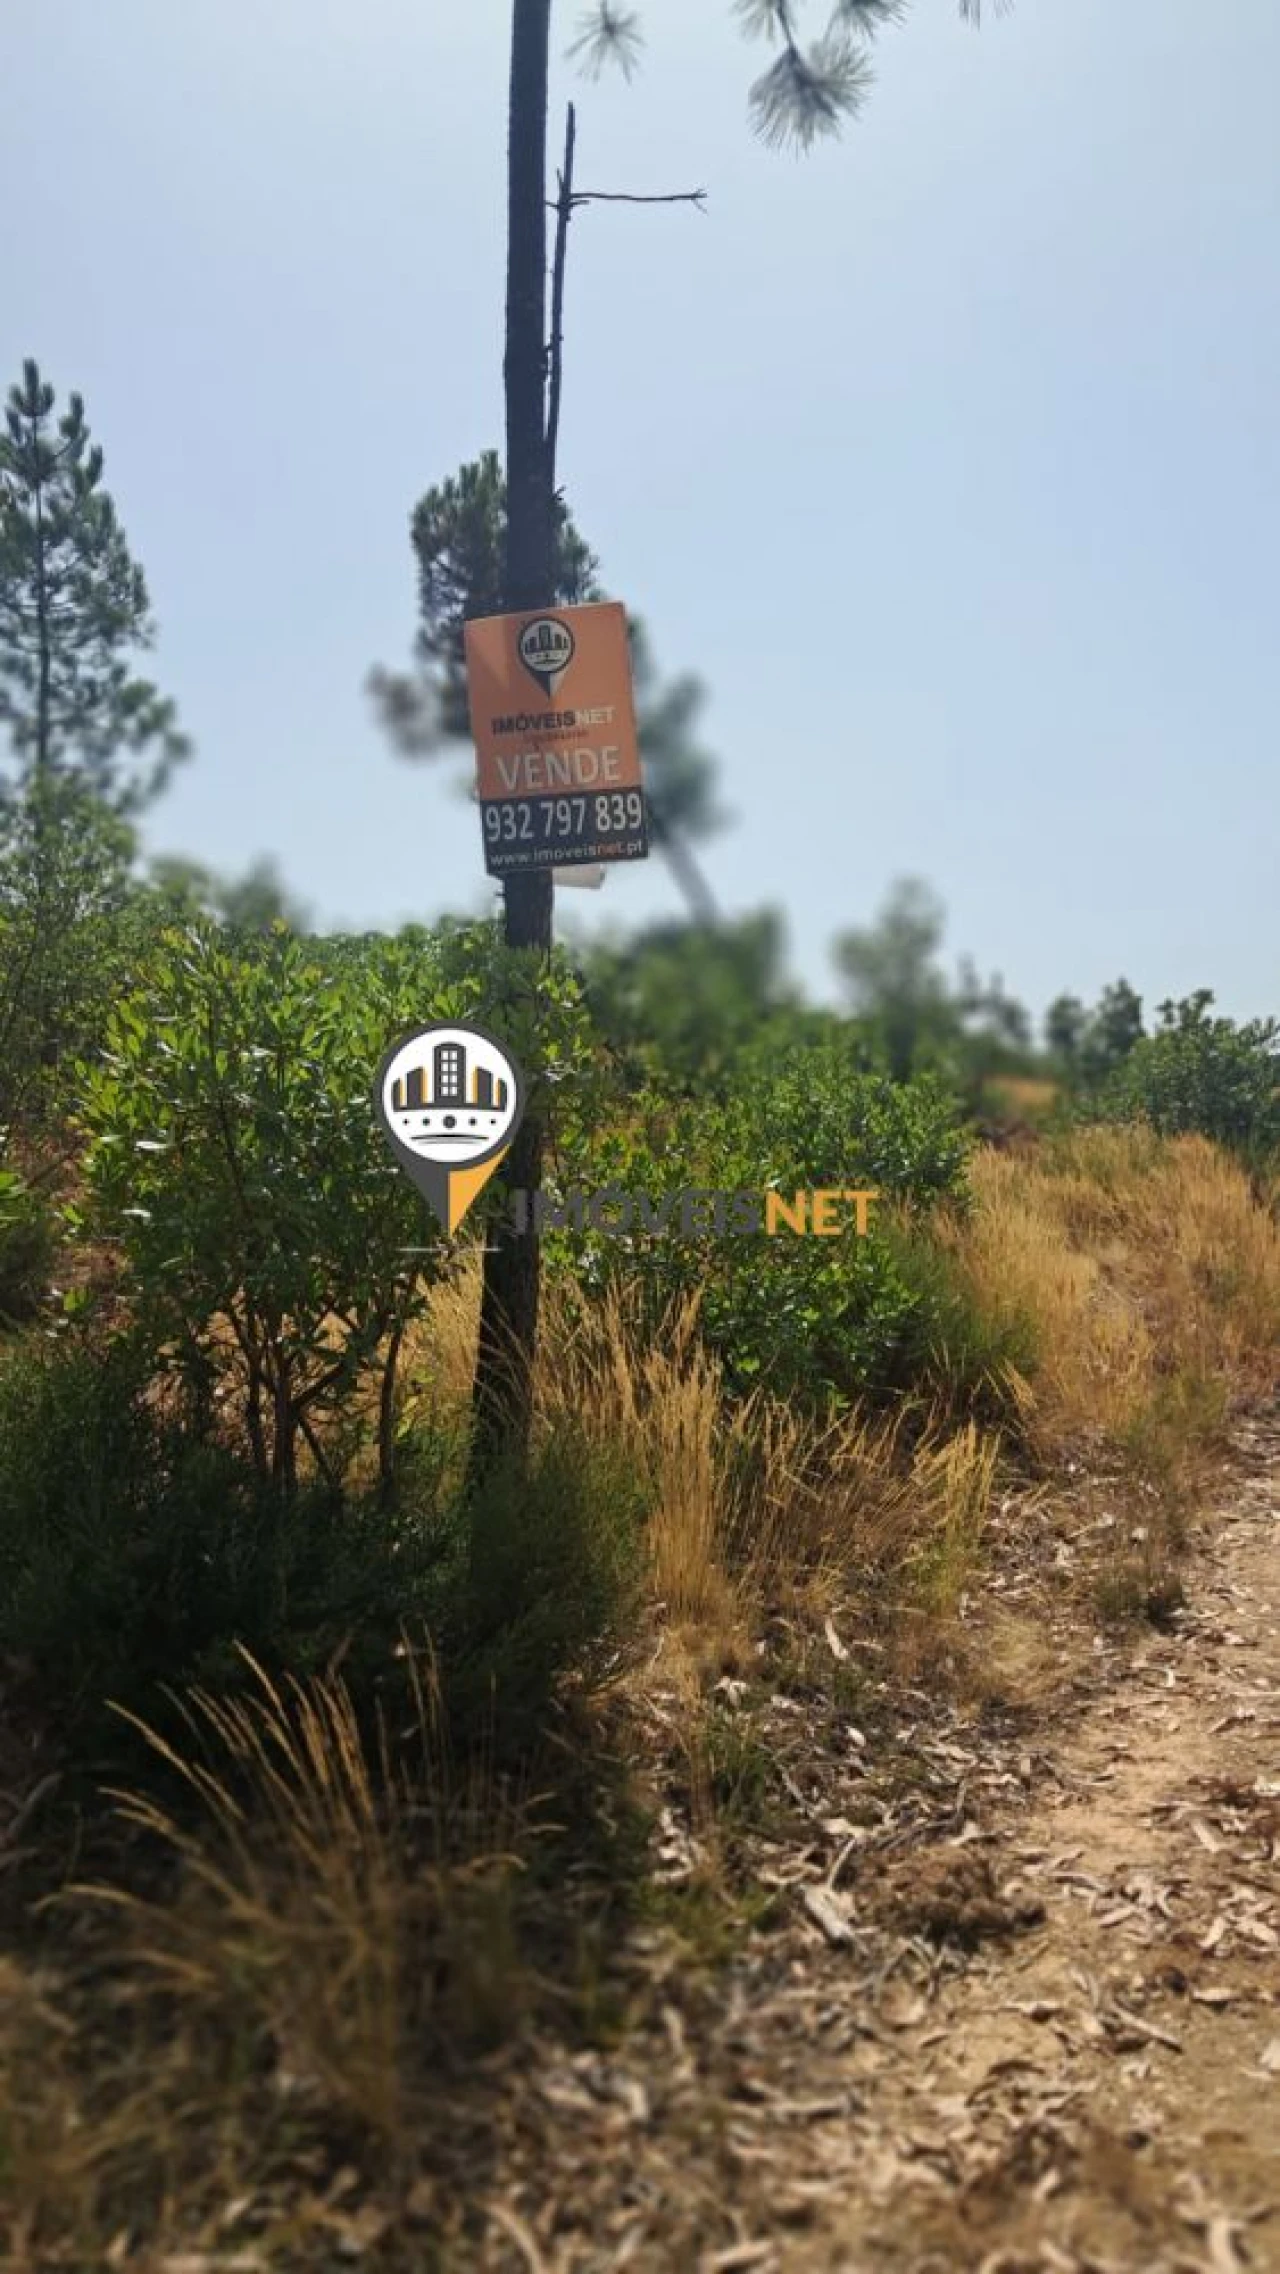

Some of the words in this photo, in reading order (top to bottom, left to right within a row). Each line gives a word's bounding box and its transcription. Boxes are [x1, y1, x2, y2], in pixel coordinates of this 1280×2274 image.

[496, 746, 620, 790] VENDE
[486, 804, 534, 842] 932
[540, 798, 585, 836] 797
[595, 793, 642, 831] 839
[490, 840, 642, 865] www.imoveisnet.pt
